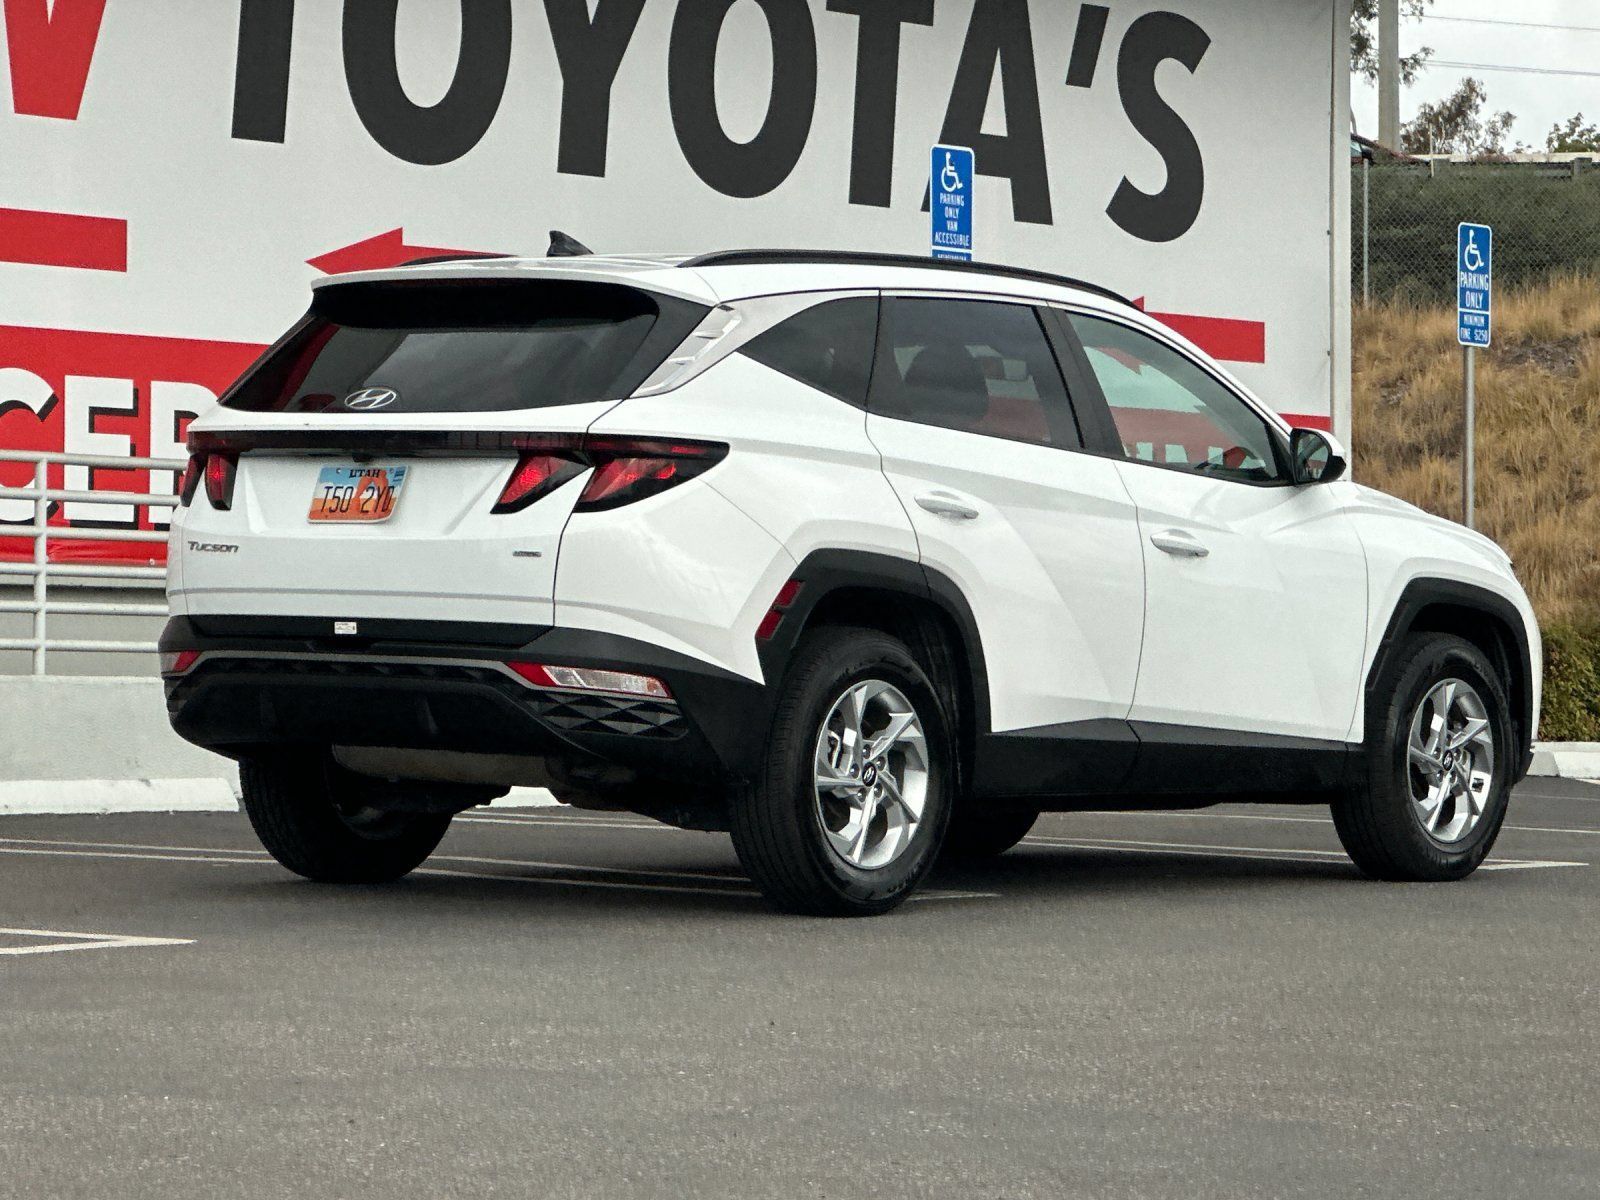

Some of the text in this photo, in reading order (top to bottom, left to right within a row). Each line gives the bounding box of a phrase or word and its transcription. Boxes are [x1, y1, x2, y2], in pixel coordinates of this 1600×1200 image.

[940, 193, 965, 206] PARKING
[944, 206, 960, 219] ONLY
[946, 220, 958, 231] VAN
[935, 232, 970, 247] ACCESSIBLE
[1460, 272, 1489, 290] PARKING
[1465, 291, 1484, 308] ONLY
[349, 468, 380, 479] UTAH
